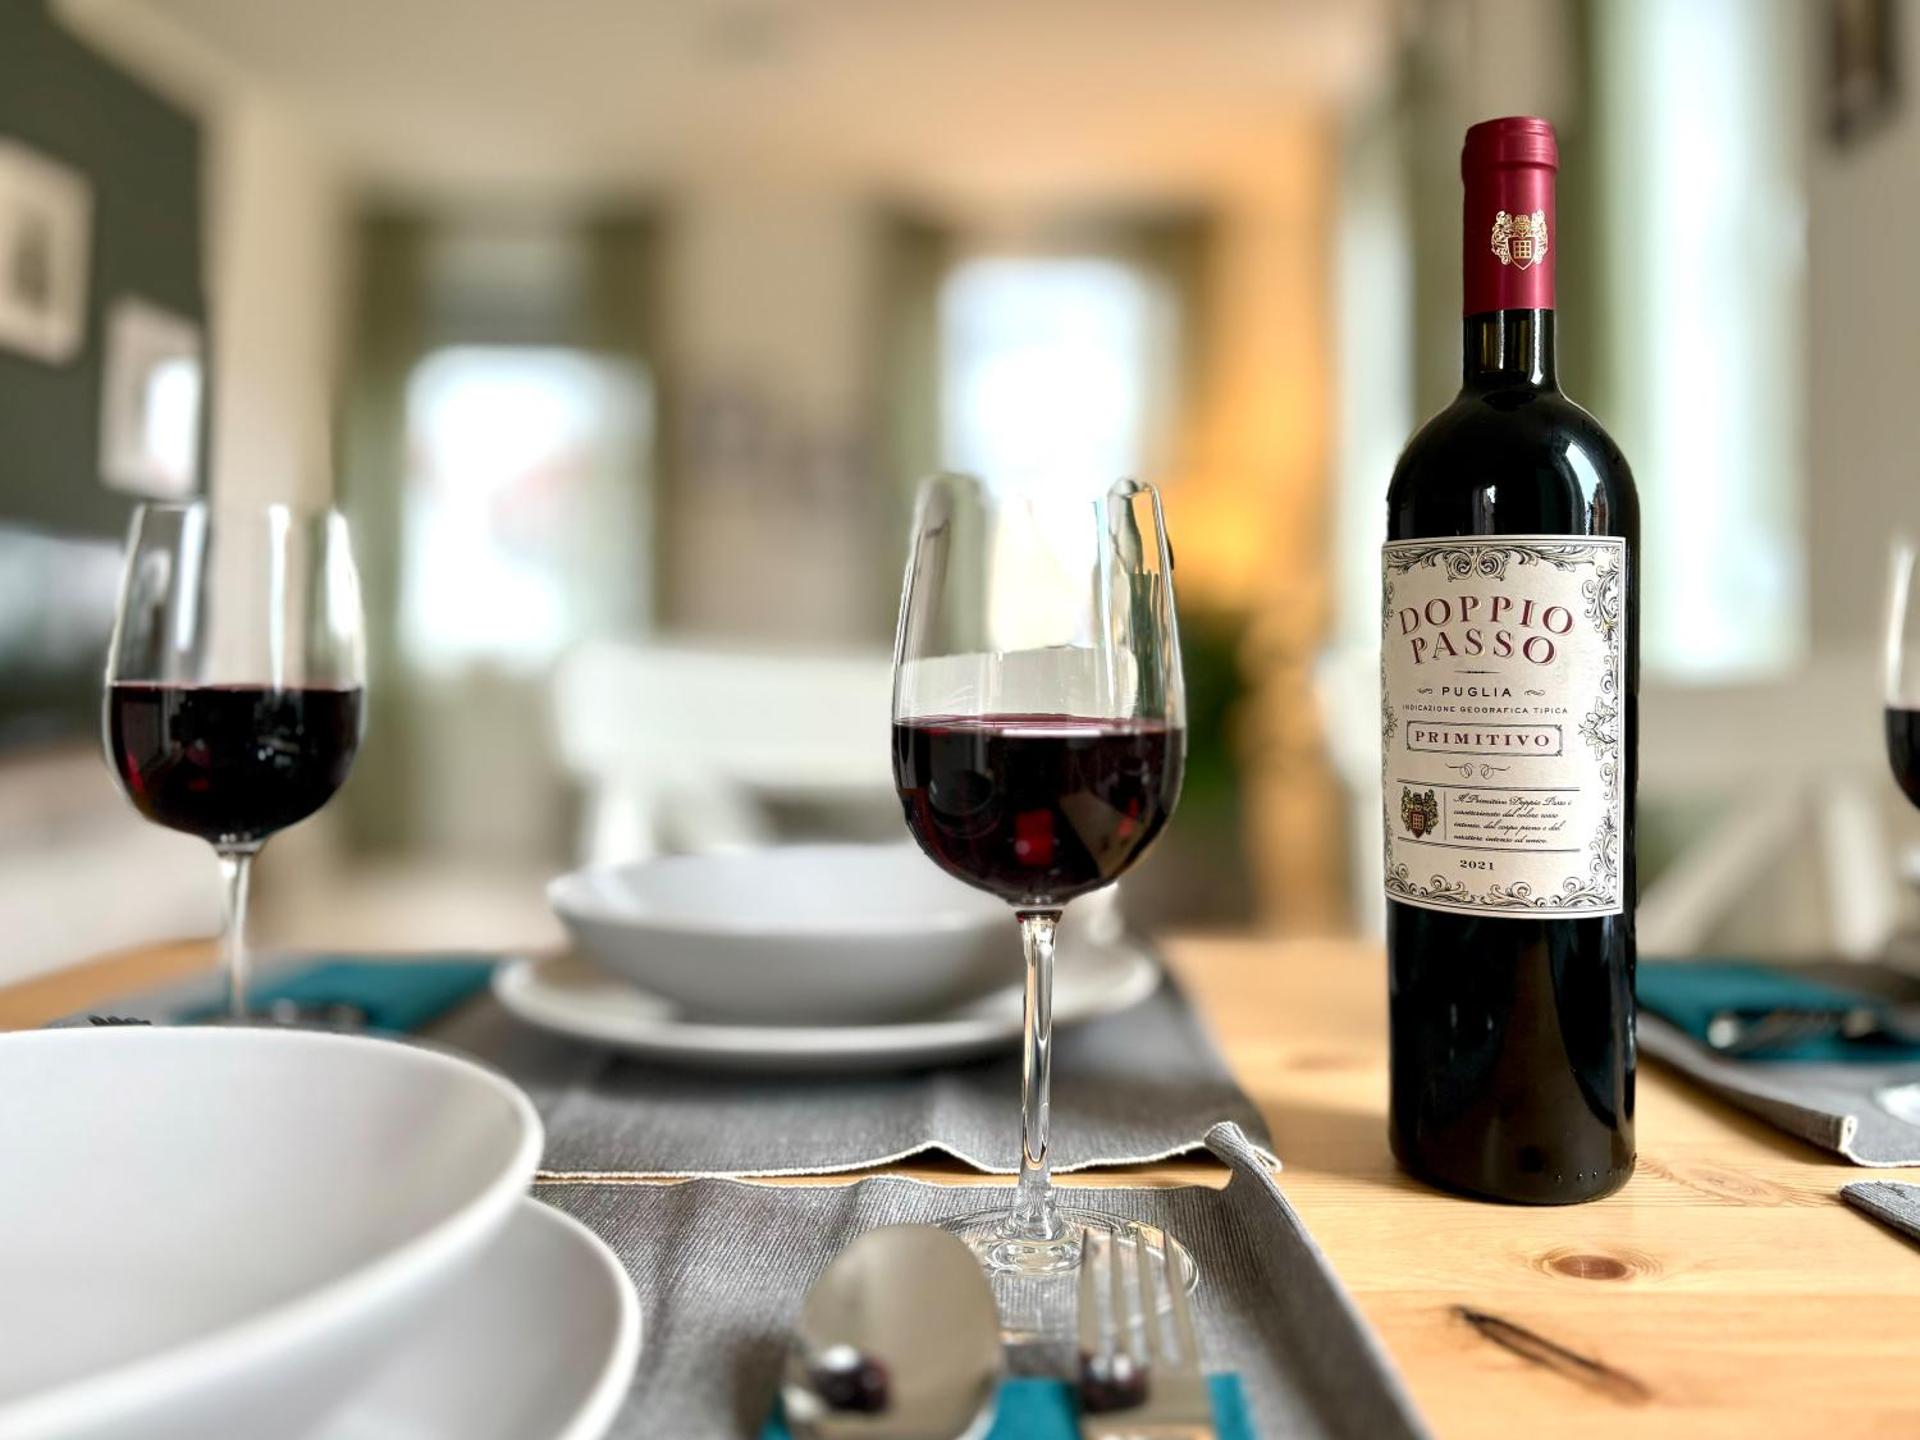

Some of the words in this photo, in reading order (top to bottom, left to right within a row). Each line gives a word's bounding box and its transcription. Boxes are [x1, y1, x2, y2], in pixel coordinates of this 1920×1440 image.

[1398, 595, 1575, 636] DOPPIO
[1410, 627, 1558, 666] PASSO
[1441, 686, 1512, 697] PUGLIA
[1402, 703, 1456, 713] INDICAZIONE
[1460, 705, 1528, 714] GEOGRAFICA
[1533, 706, 1568, 715] TIPICA
[1415, 729, 1550, 748] PRIMITIVO
[1459, 859, 1495, 871] 2021
